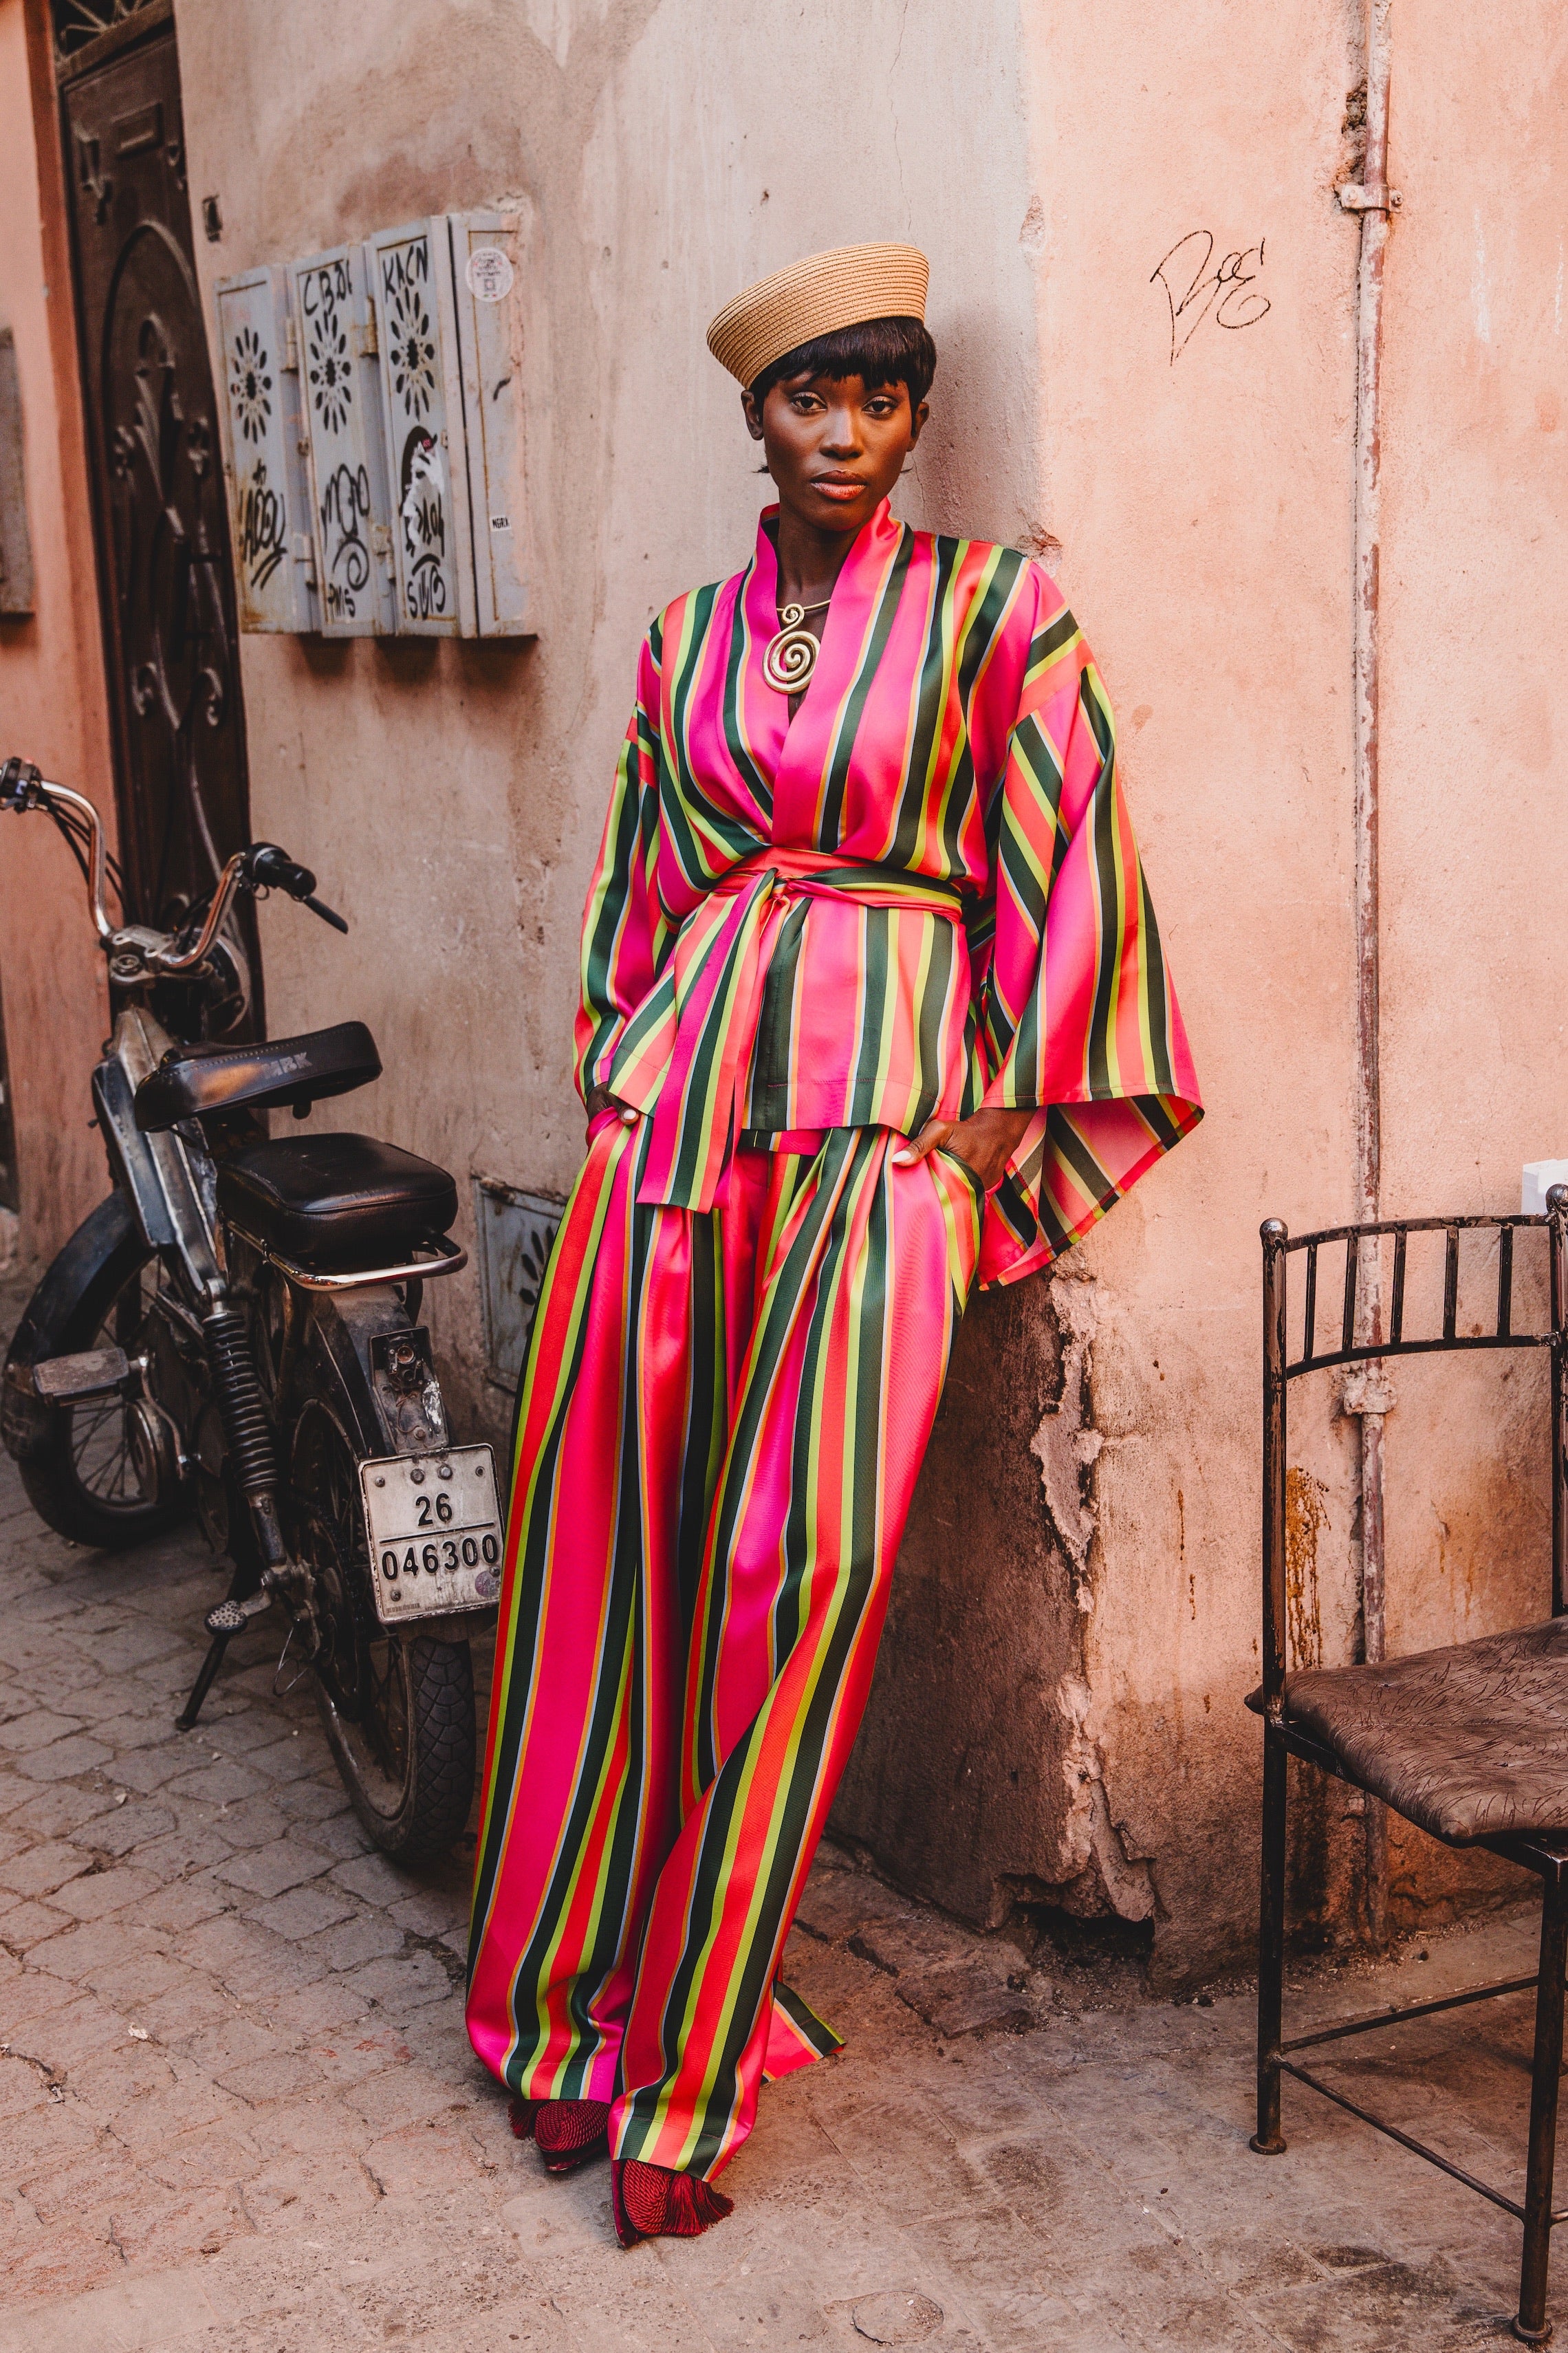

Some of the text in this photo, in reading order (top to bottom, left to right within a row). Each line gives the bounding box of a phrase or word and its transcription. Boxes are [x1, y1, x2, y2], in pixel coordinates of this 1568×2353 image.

[261, 1052, 313, 1080] MBK
[415, 1493, 453, 1526] 26
[382, 1534, 498, 1580] 046300
